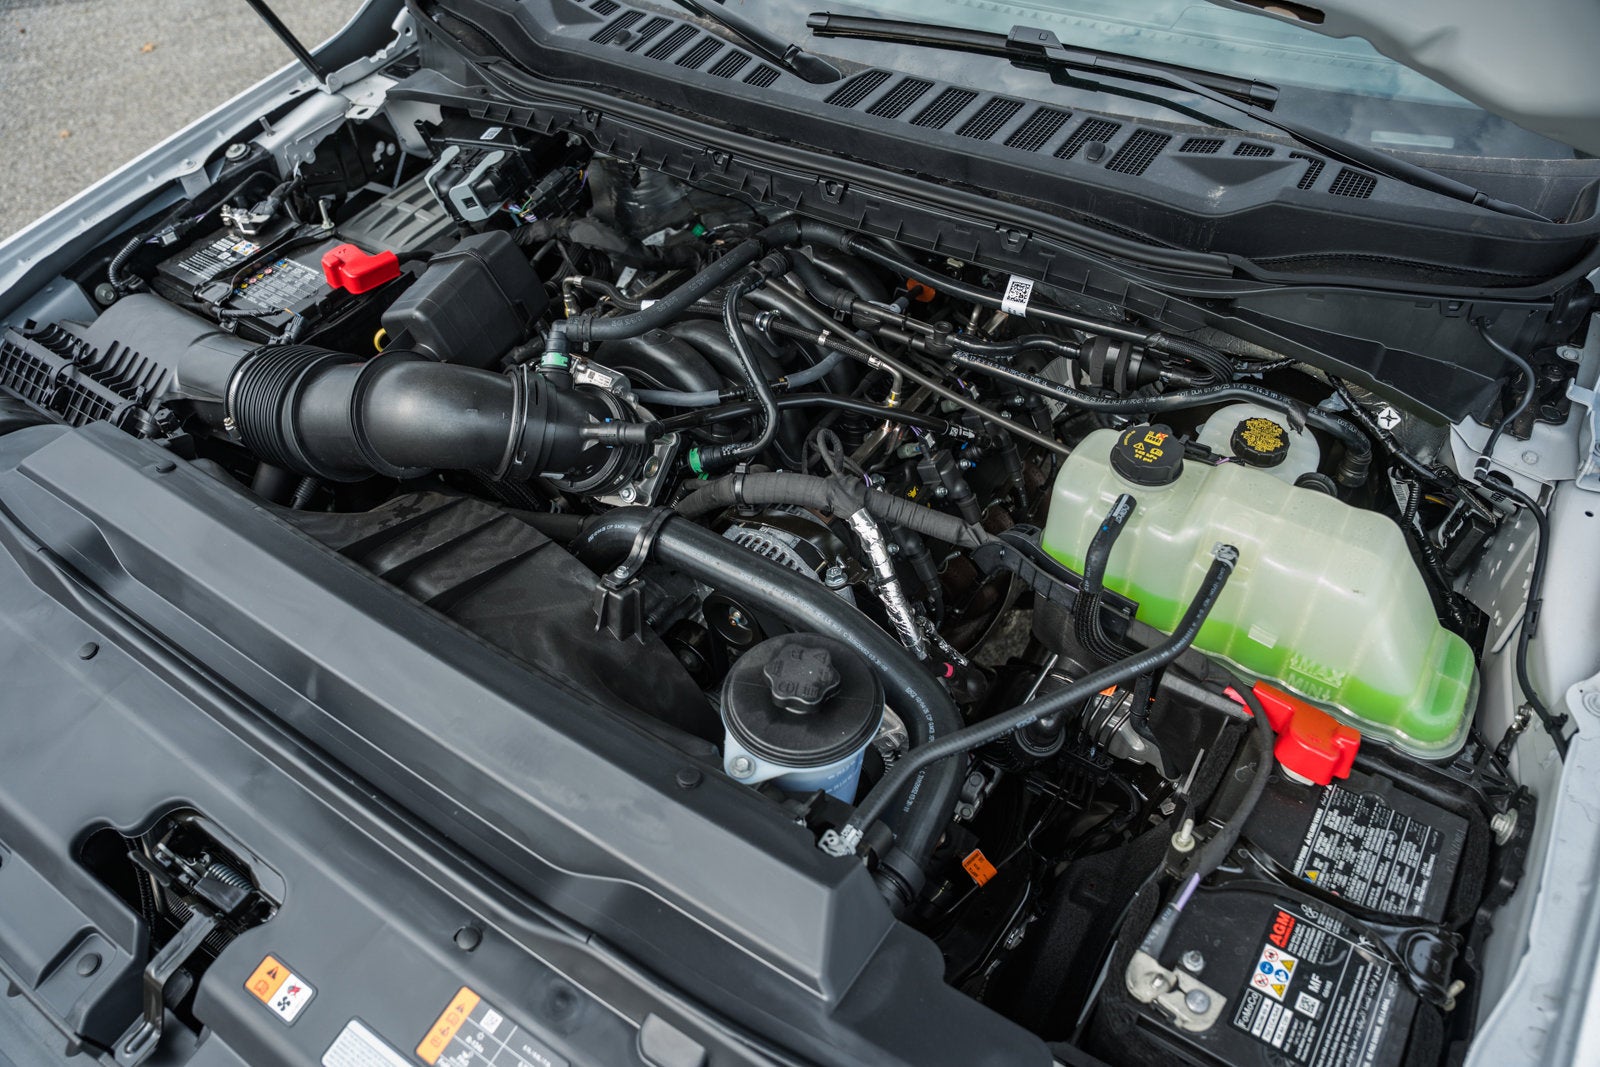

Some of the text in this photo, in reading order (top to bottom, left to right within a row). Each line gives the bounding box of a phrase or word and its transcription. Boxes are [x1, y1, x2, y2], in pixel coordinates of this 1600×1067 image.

[1298, 655, 1345, 687] MAX
[1269, 911, 1291, 947] AGM
[1308, 973, 1322, 993] MF
[1237, 991, 1259, 1029] FoMoCo
